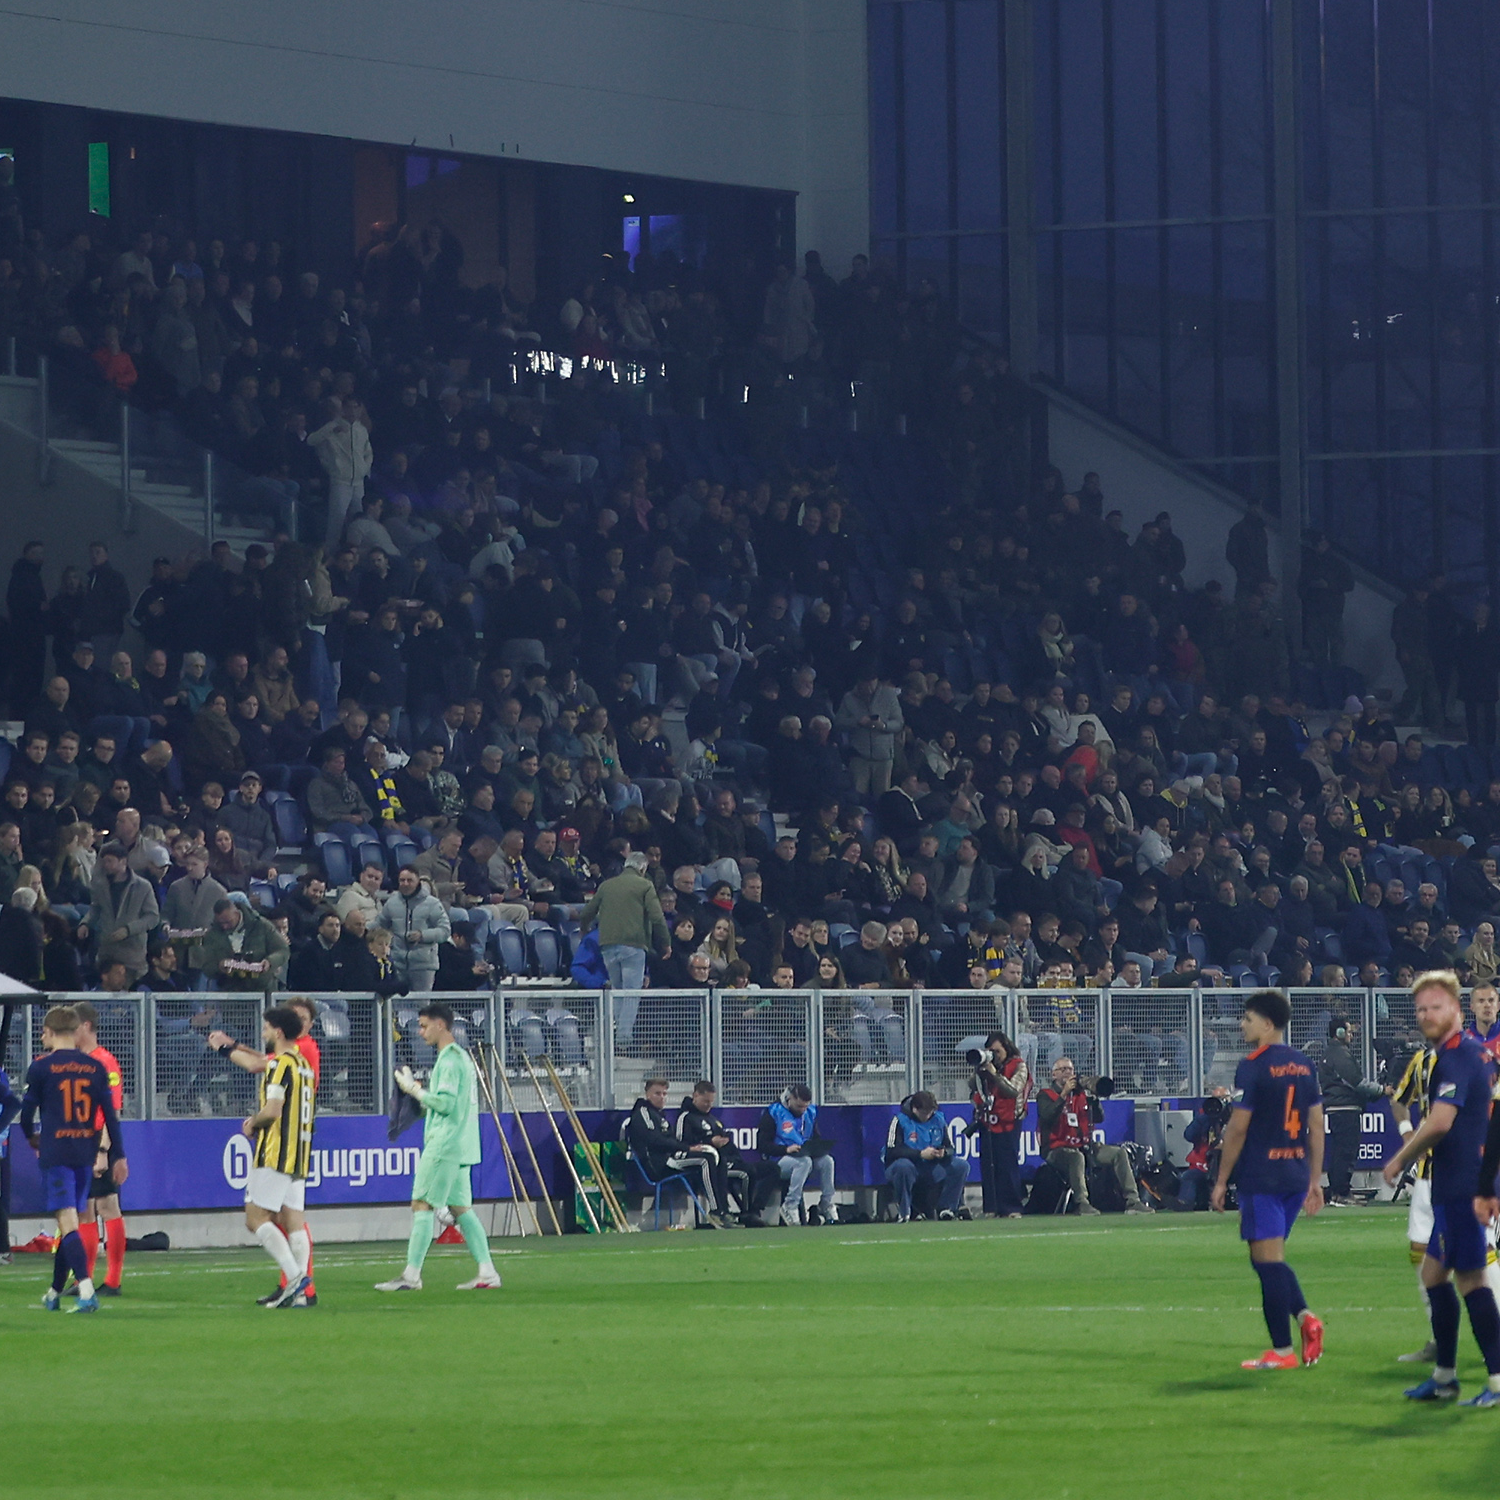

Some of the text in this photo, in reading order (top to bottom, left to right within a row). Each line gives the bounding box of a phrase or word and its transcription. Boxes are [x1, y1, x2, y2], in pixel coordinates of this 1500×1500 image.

[58, 1078, 92, 1123] 15
[1283, 1084, 1302, 1140] 4
[223, 1133, 420, 1188] bguignon
